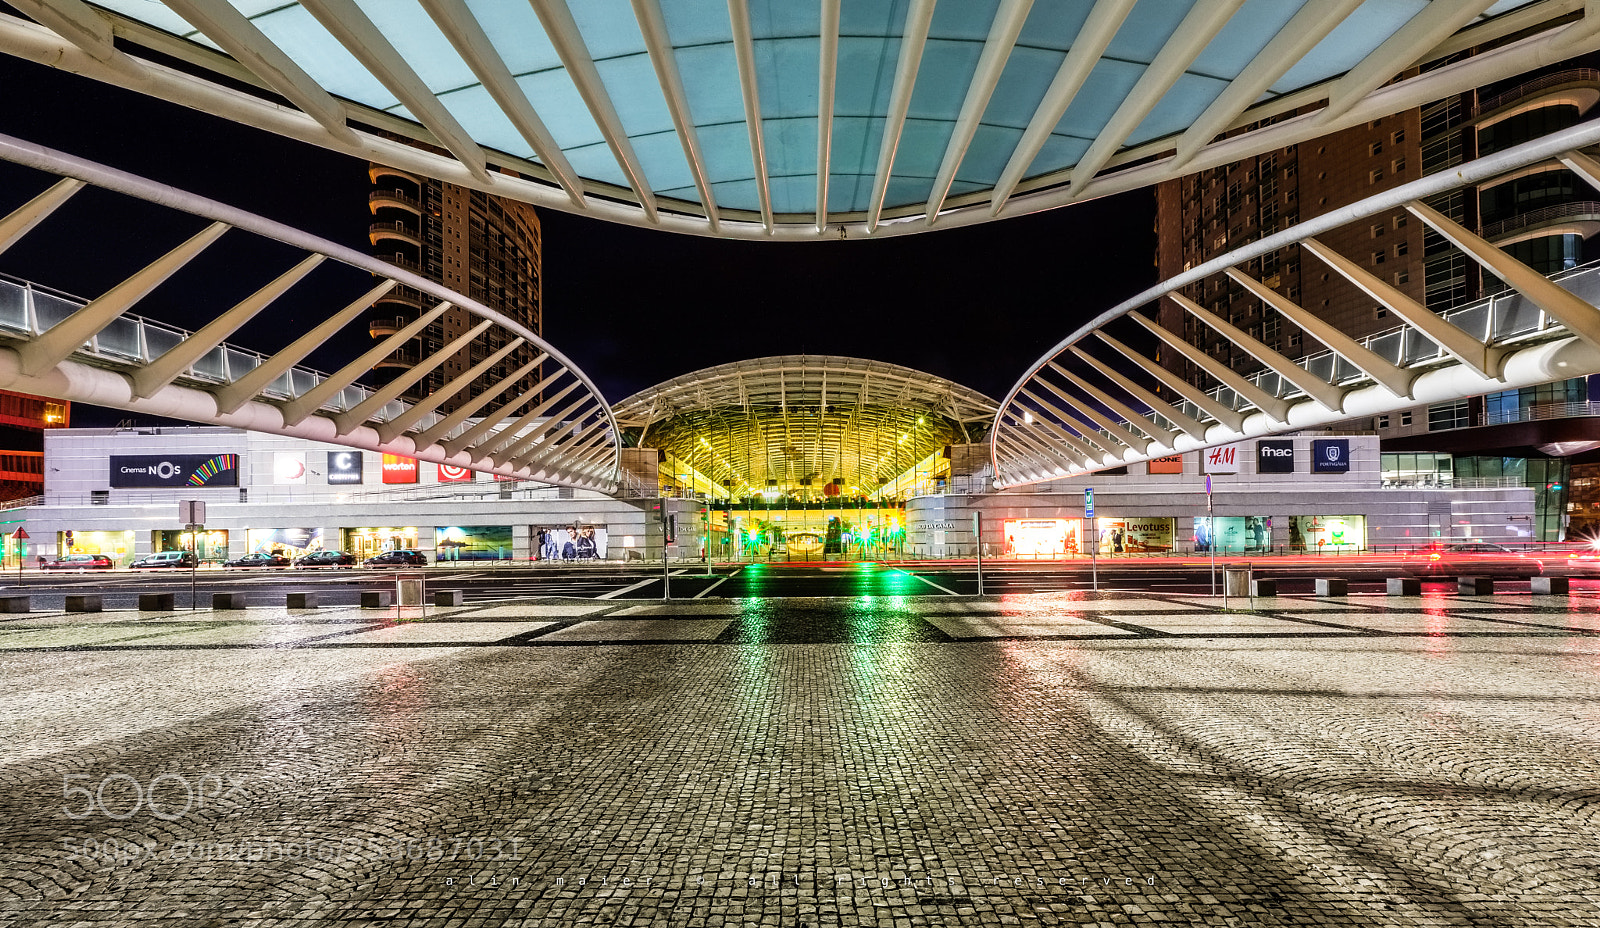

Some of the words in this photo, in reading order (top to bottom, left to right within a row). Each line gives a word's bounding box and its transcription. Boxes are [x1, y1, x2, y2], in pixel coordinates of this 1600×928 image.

[1208, 447, 1236, 466] H&M
[1261, 446, 1293, 457] fnac
[120, 466, 147, 474] Cinemas
[148, 461, 181, 479] NOS
[383, 463, 416, 471] worten
[1126, 522, 1171, 532] Levotuss
